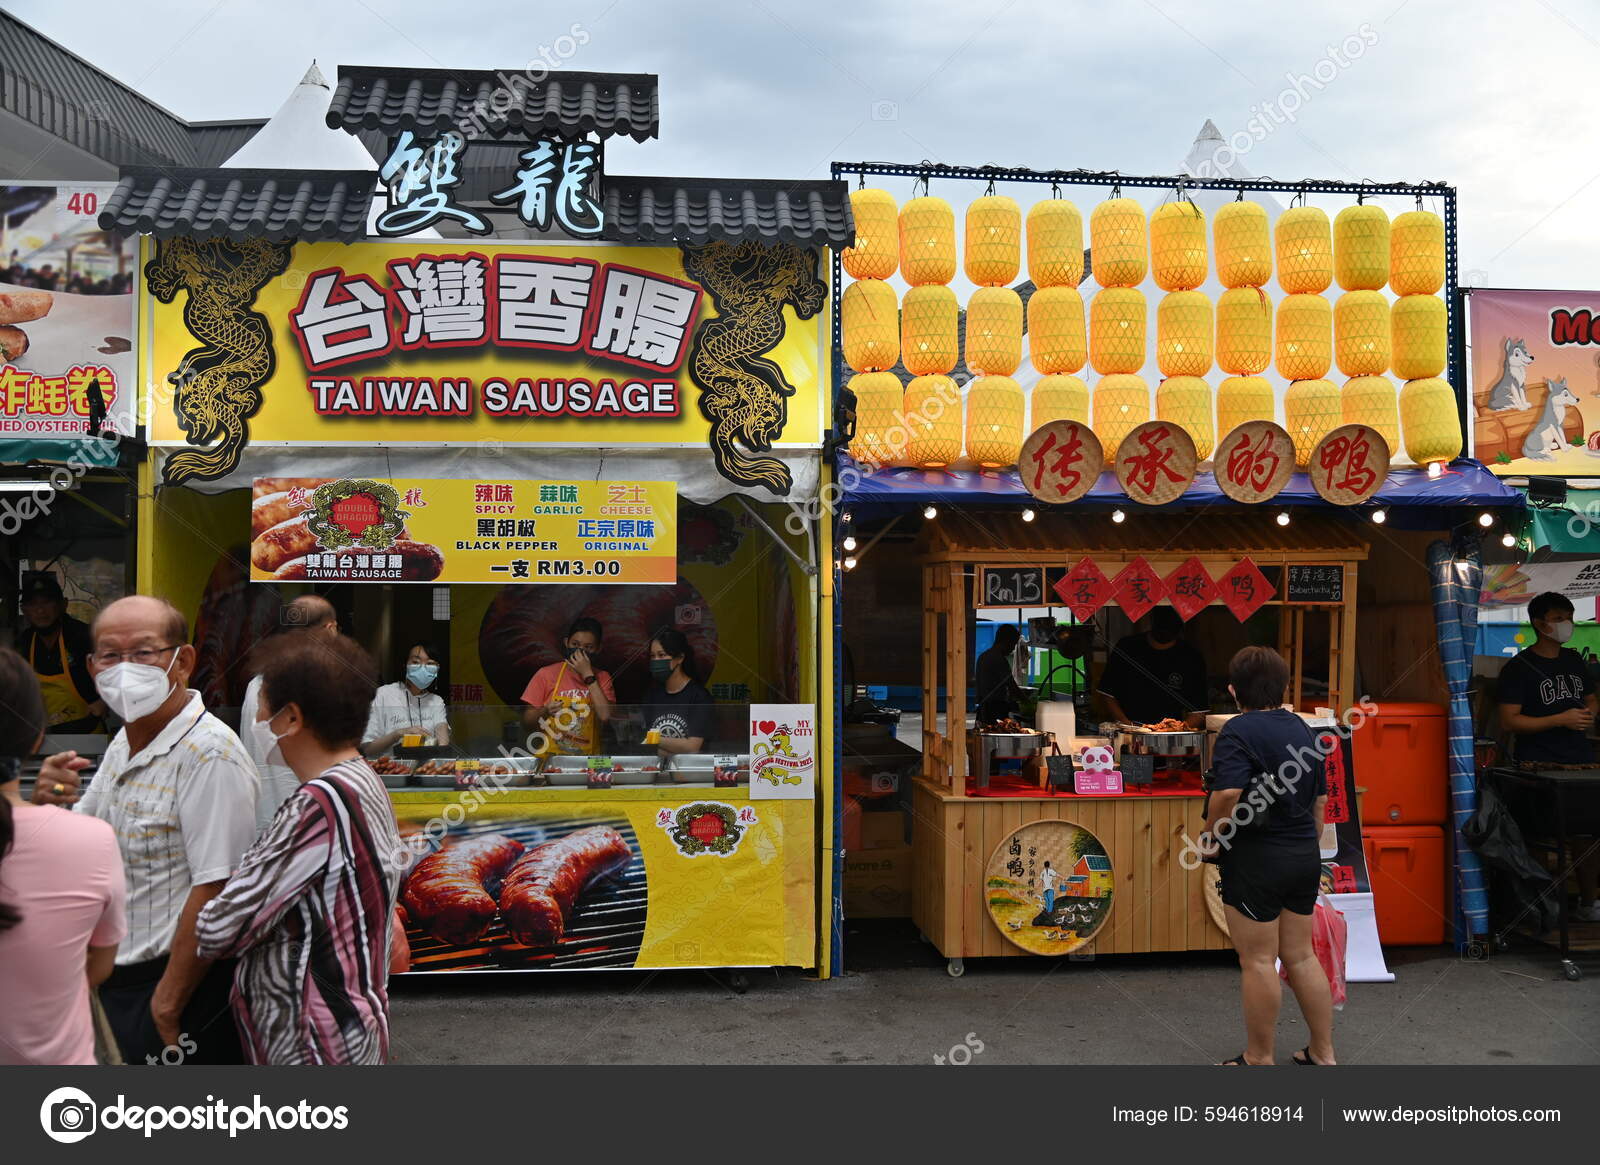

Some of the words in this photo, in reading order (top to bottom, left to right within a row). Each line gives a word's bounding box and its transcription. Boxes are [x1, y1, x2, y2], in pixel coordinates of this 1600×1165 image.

[67, 192, 97, 215] 40
[295, 256, 700, 368] 台灣香腸
[1551, 309, 1600, 346] M
[311, 381, 469, 412] TAIWAN
[485, 381, 674, 413] SAUSAGE
[26, 420, 79, 432] OYSTER
[1033, 425, 1377, 496] 传承的鸭
[475, 484, 513, 503] 辣味
[540, 485, 578, 503] 蒜味
[608, 485, 645, 504] 芝士
[338, 504, 374, 512] DOUBLE
[475, 505, 515, 514] SPICY
[533, 505, 583, 515] GARLIC
[600, 506, 652, 515] CHEESE
[336, 513, 375, 522] DRAGON
[477, 519, 536, 538] 黑胡椒
[577, 520, 655, 538] 正宗原味
[456, 541, 500, 551] BLACK
[506, 541, 558, 551] PEPPER
[584, 542, 649, 551] ORIGINAL
[306, 569, 348, 579] TAIWAN
[351, 569, 402, 579] SAUSAGE
[490, 560, 530, 578] 一支
[537, 560, 620, 576] RM3.00
[1071, 575, 1256, 606] 客家酸鸭
[1540, 675, 1584, 705] GAP
[752, 720, 757, 736] I
[794, 728, 813, 736] CITY
[797, 720, 810, 728] MY
[754, 757, 774, 774] KUCHING
[775, 758, 799, 767] FESTIVAL
